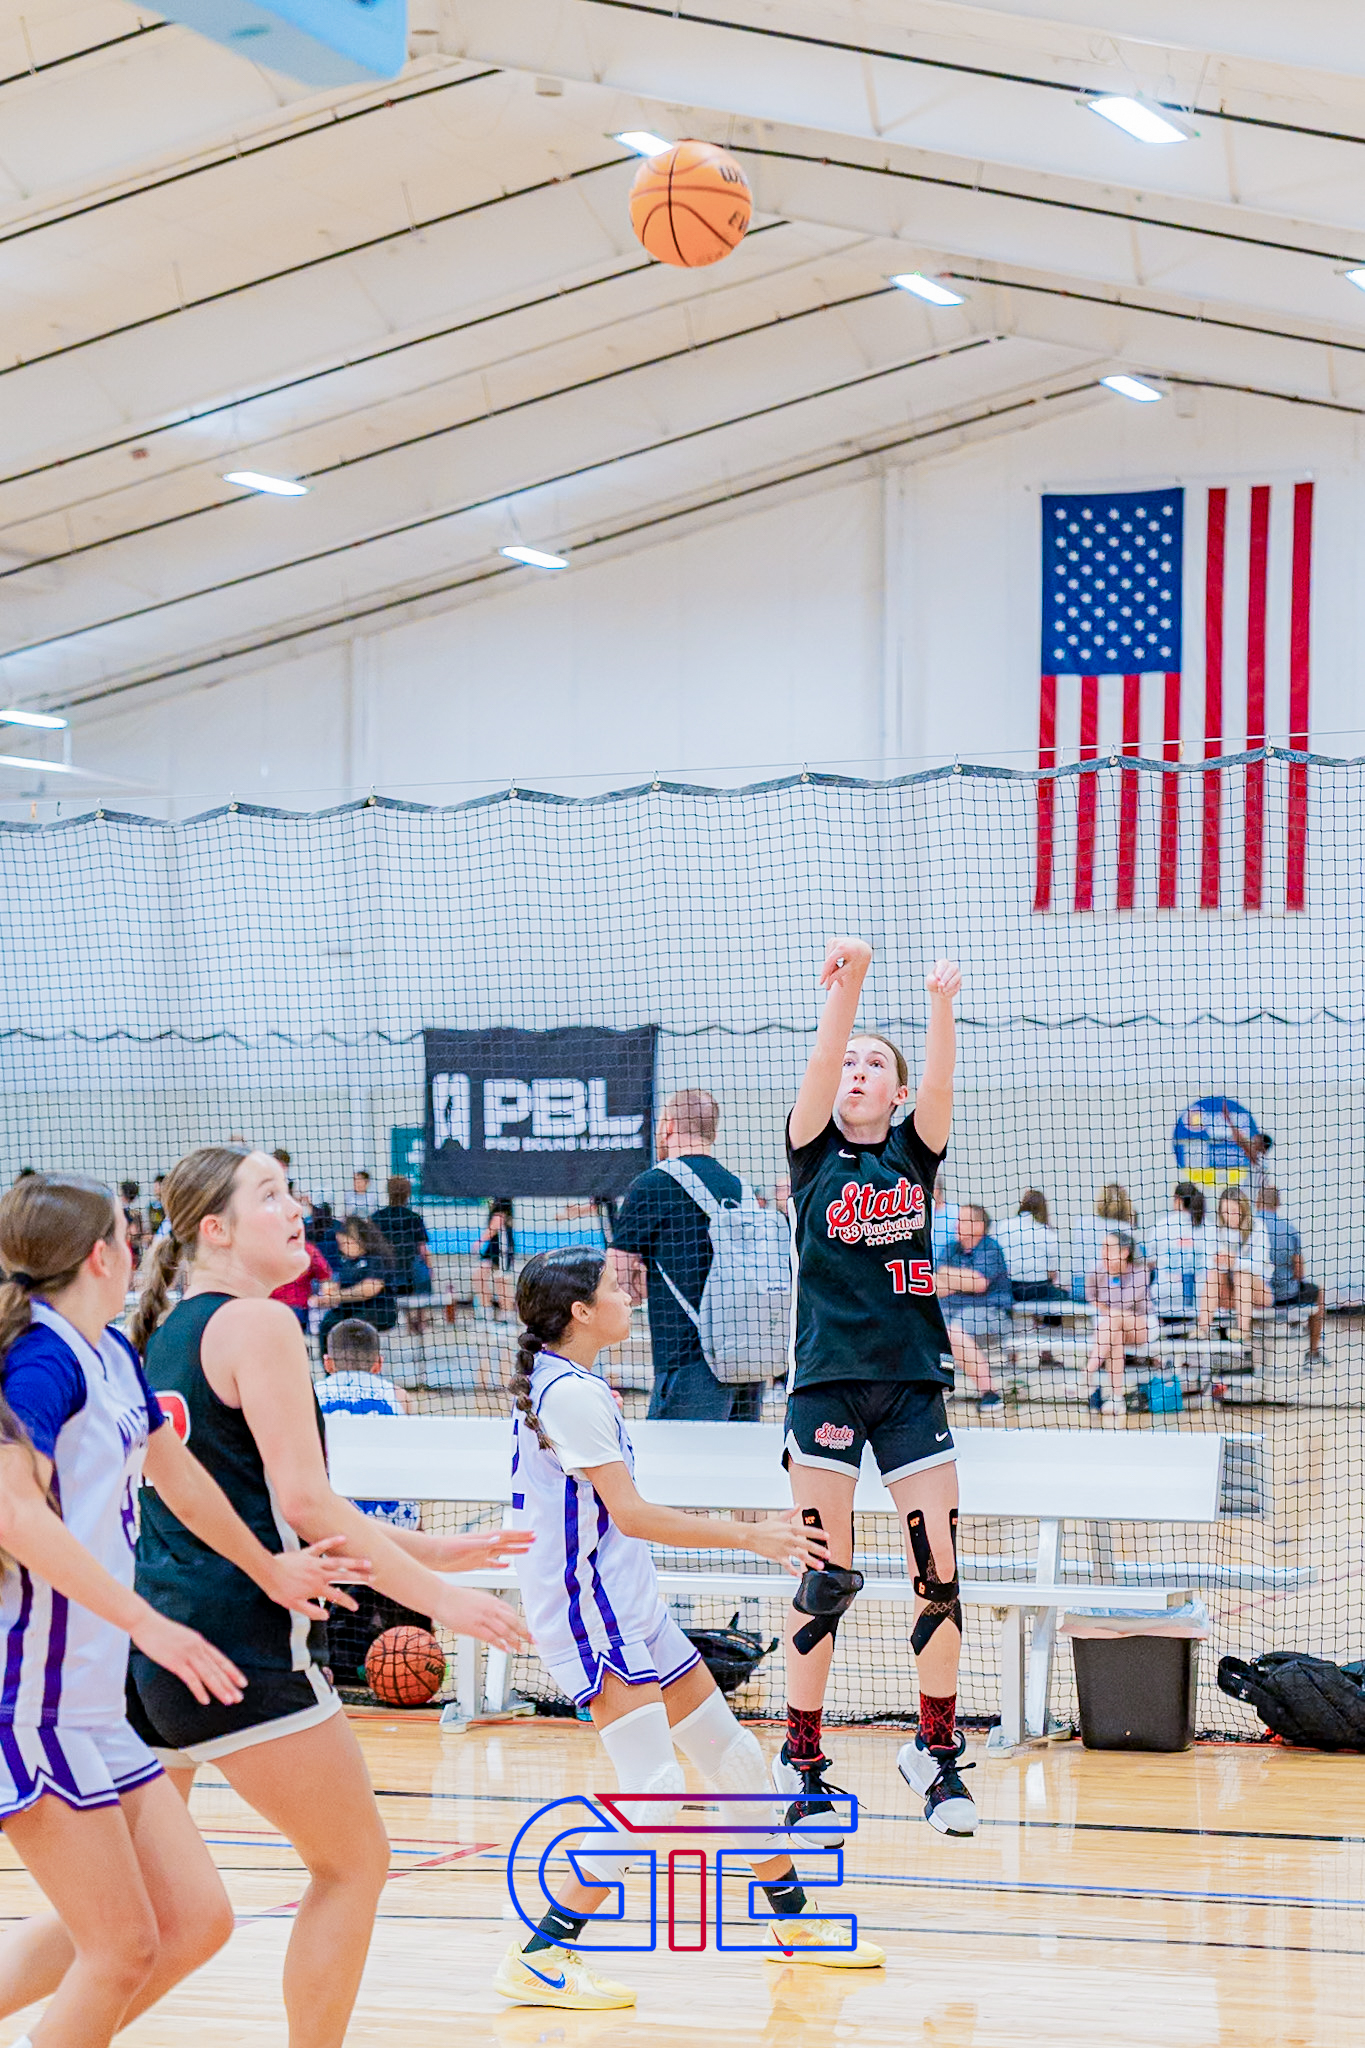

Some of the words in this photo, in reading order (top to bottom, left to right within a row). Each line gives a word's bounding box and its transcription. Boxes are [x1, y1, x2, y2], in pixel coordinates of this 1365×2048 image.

[483, 1077, 644, 1137] PBL
[826, 1177, 925, 1238] State
[841, 1225, 861, 1240] 38
[884, 1259, 937, 1296] 15
